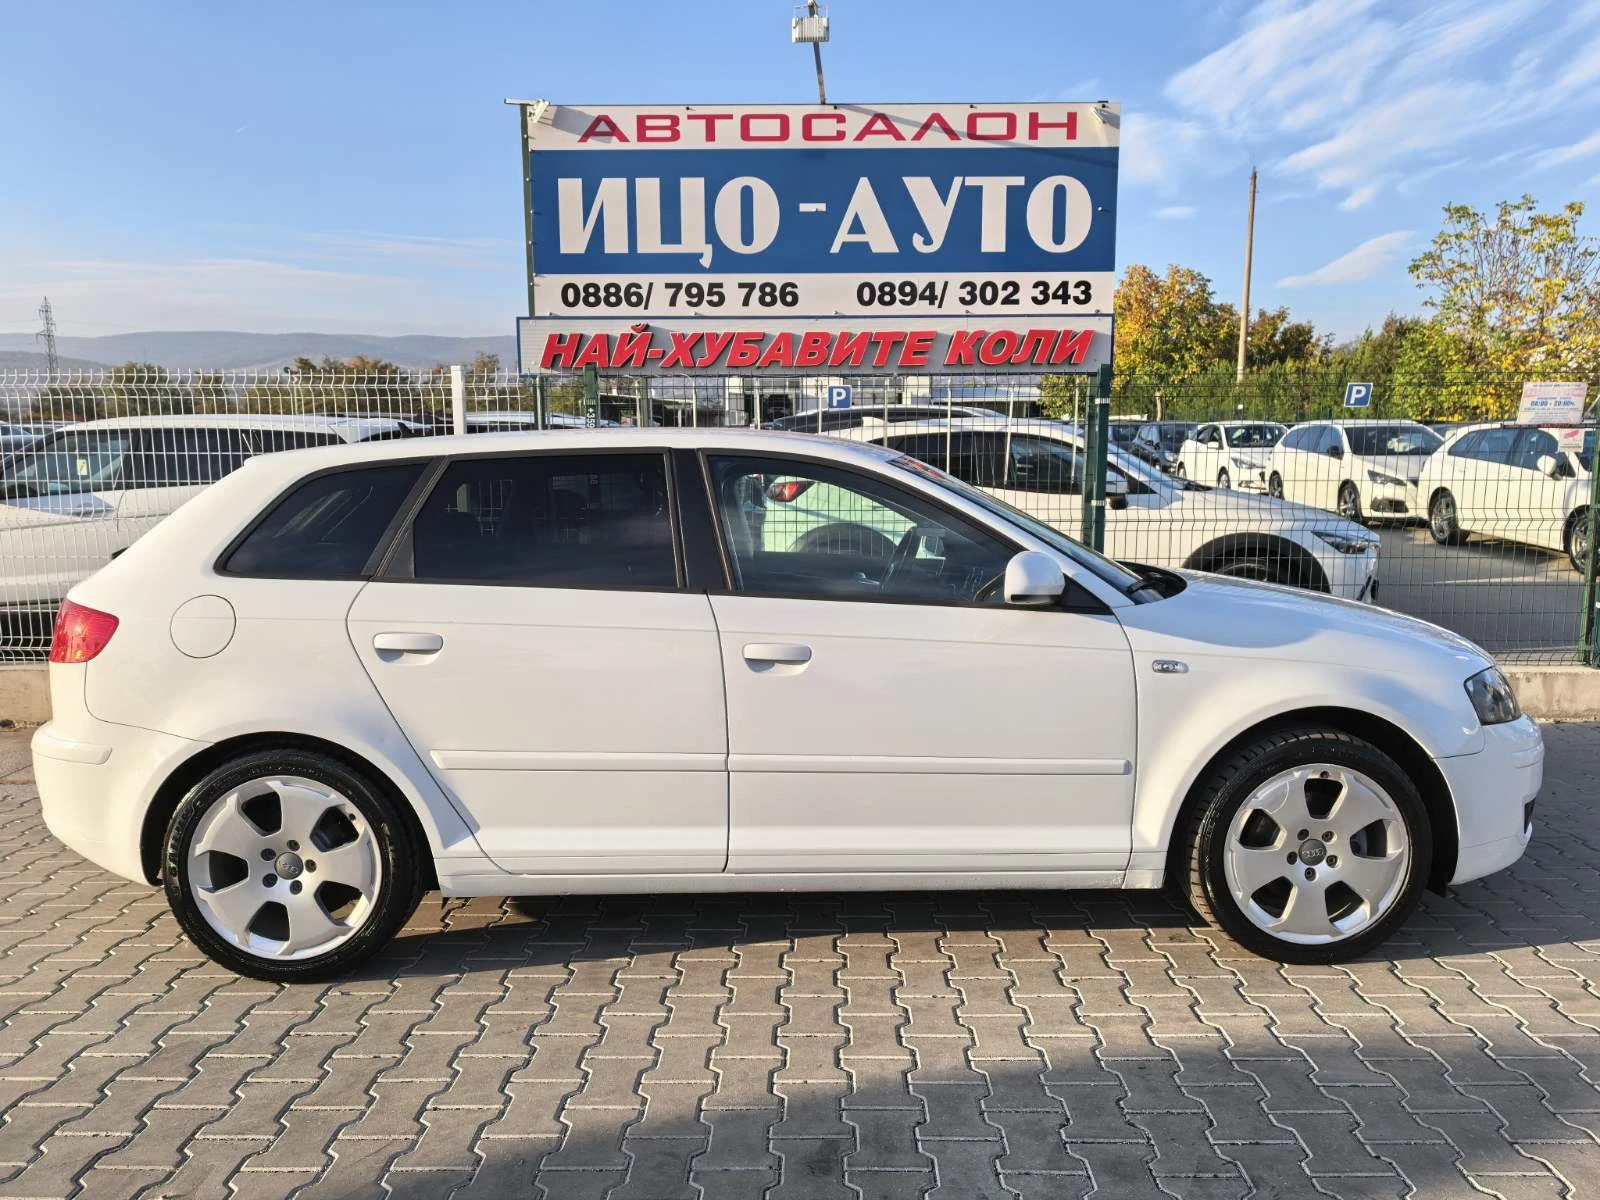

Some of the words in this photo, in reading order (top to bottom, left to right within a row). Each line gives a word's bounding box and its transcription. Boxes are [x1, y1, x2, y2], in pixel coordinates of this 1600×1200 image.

[577, 112, 1078, 143] АВТОСАЛОН
[557, 175, 780, 269] ИЦО
[830, 175, 1093, 254] АУТО
[560, 281, 654, 310] 0886/
[667, 281, 726, 307] 795
[737, 281, 799, 307] 786
[856, 280, 948, 309] 0894/
[958, 280, 1020, 306] 302
[1030, 280, 1092, 306] 343
[540, 324, 937, 369] НАЙ-ХУБАВИТЕ
[945, 328, 1095, 366] КОЛИ
[831, 388, 846, 406] P
[1350, 386, 1366, 404] P
